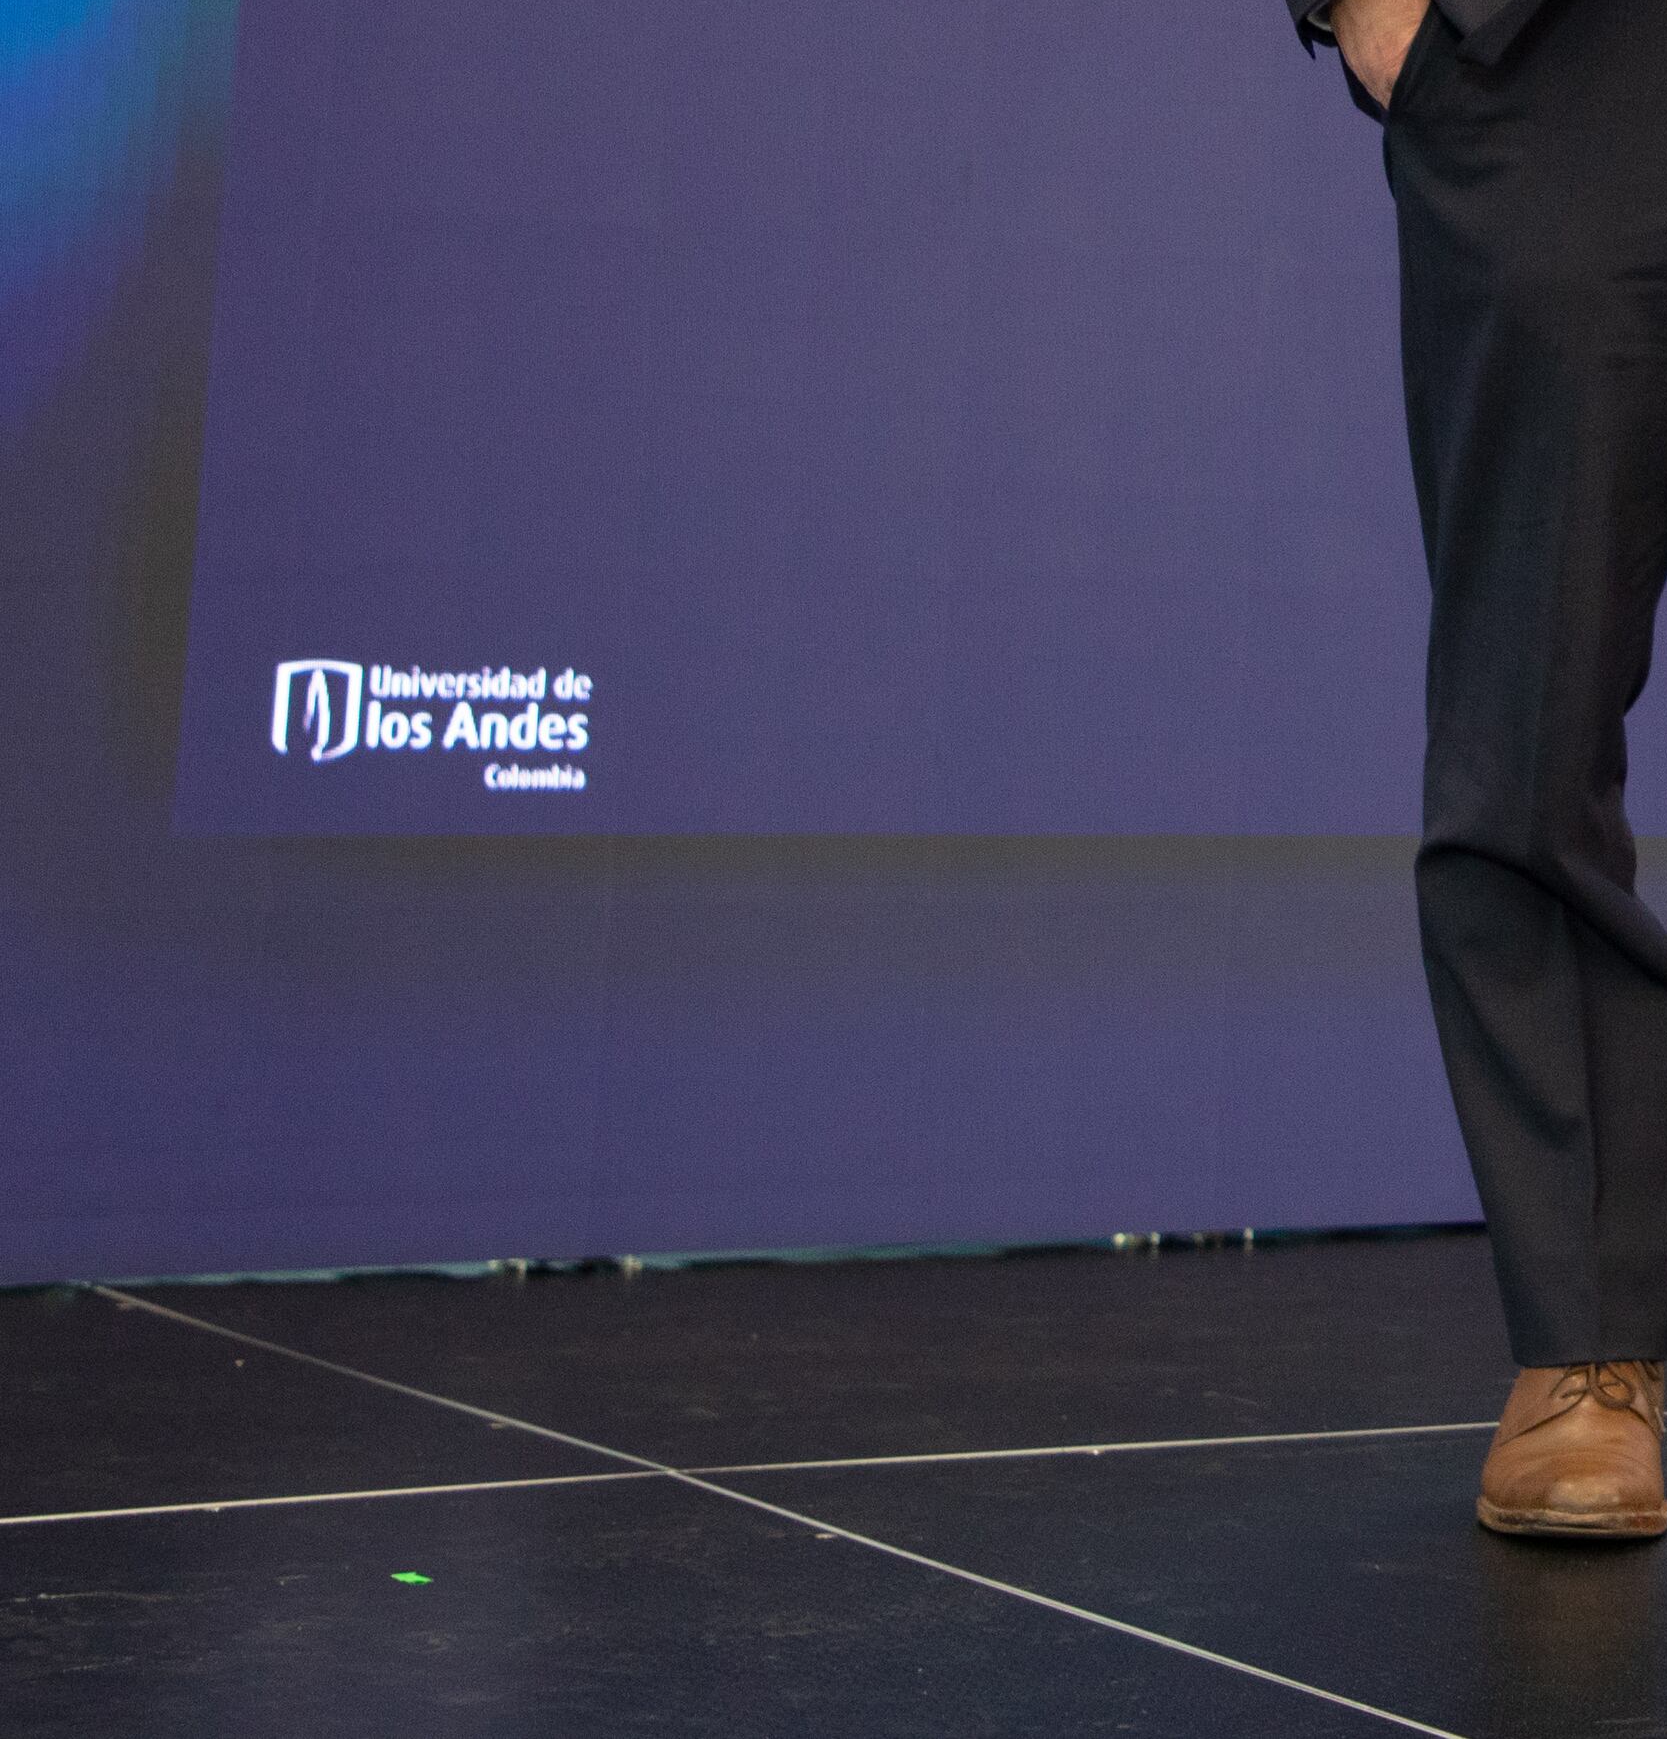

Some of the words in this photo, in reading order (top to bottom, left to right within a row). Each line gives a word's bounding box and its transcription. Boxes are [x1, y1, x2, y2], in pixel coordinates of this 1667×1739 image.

[369, 665, 547, 700] Universidad
[553, 667, 593, 700] de
[365, 700, 433, 749] los
[442, 701, 590, 750] Andes
[484, 763, 587, 790] Colombia
